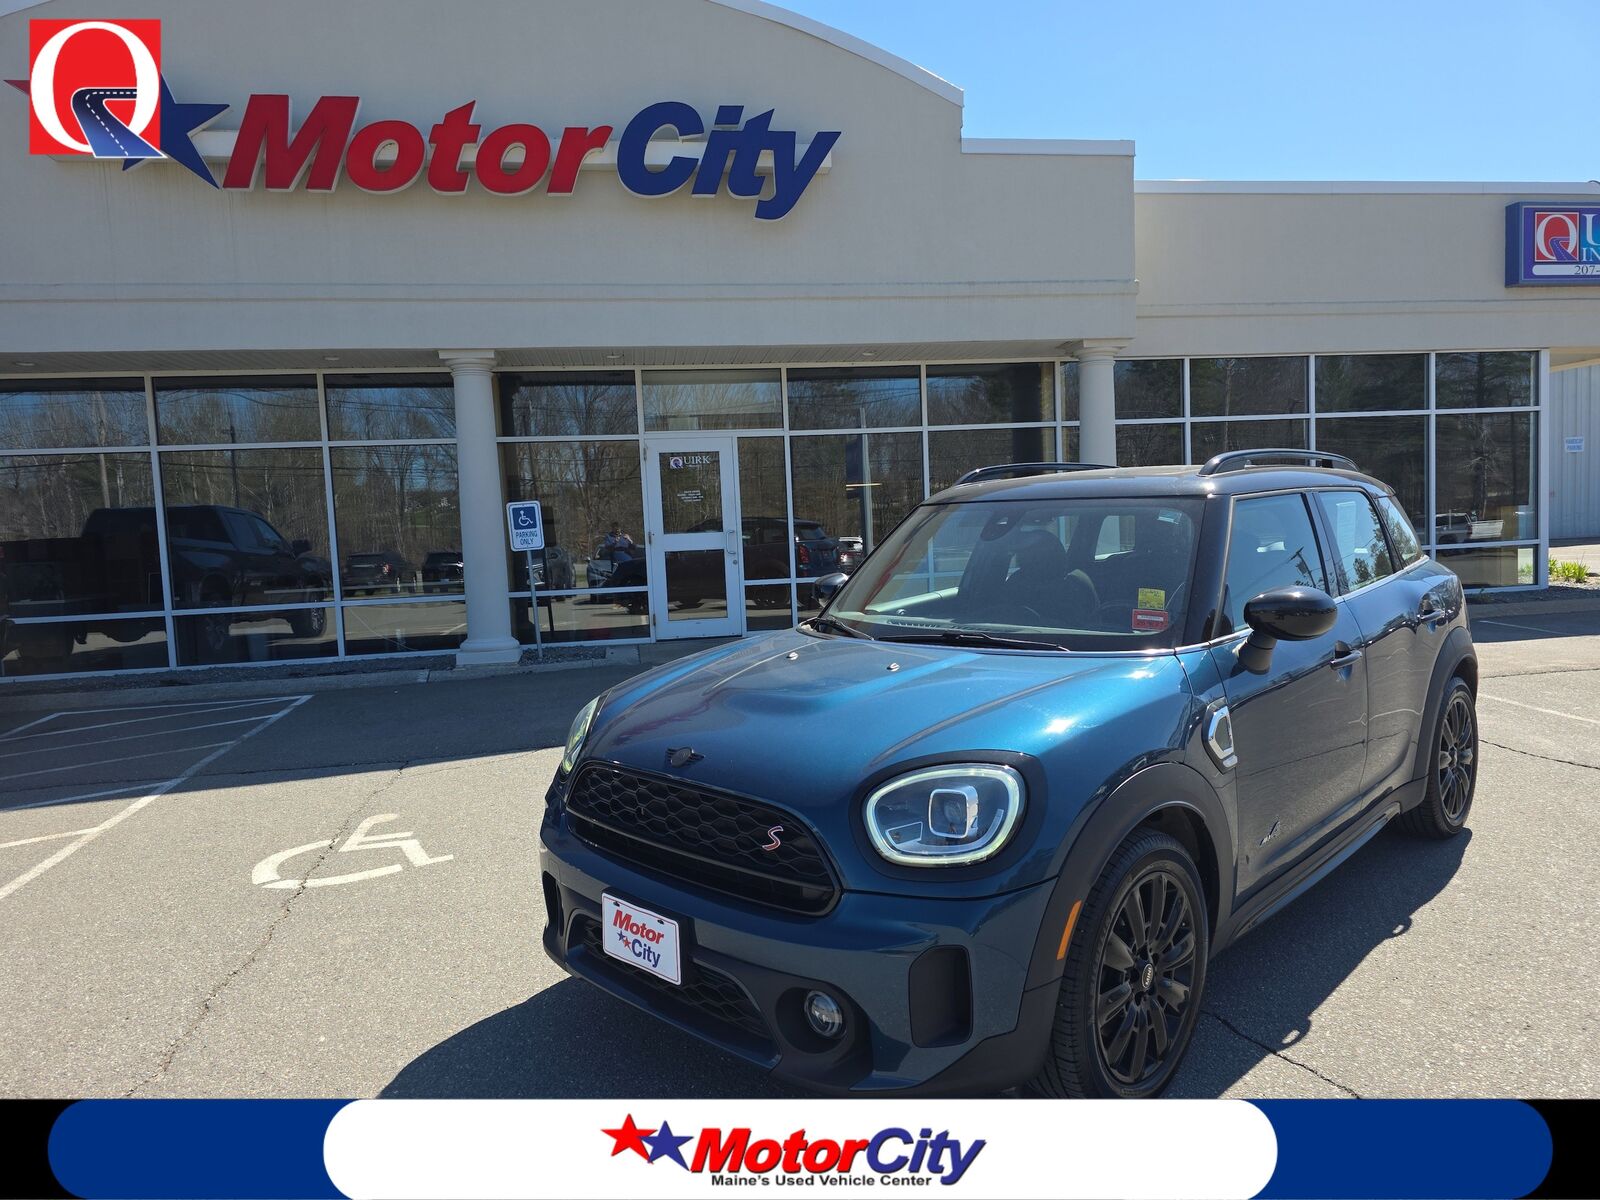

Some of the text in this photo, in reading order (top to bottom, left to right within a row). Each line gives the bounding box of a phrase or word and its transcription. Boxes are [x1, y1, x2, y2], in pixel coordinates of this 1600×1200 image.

[222, 95, 842, 220] MotorCity
[762, 825, 784, 851] S
[613, 909, 664, 944] Motor
[631, 938, 661, 968] City
